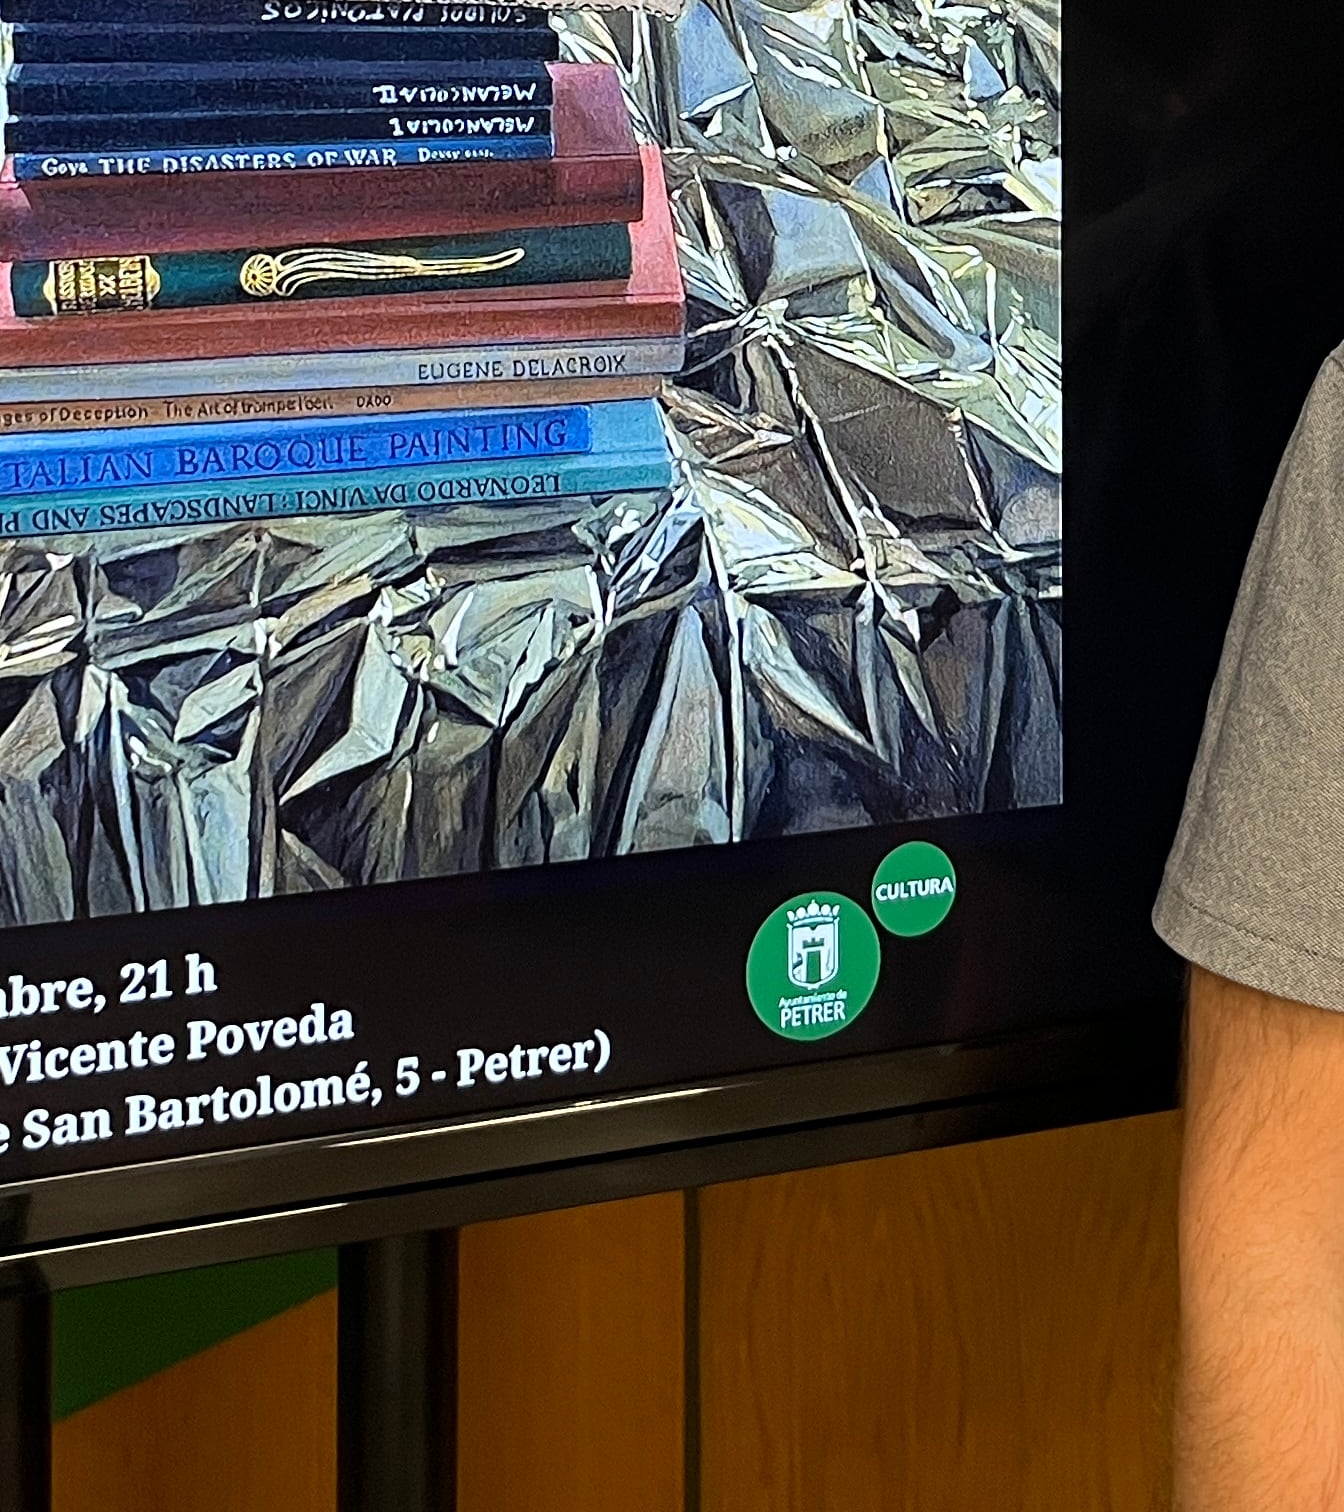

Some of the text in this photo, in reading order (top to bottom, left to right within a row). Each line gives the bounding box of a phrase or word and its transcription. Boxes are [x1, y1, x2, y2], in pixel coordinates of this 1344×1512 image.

[399, 82, 537, 103] MELANCOLIA
[406, 116, 535, 135] MELANCOLIA
[99, 156, 151, 175] THE
[162, 152, 297, 174] DISASTERS
[306, 151, 338, 167] OF
[344, 148, 397, 167] WAR
[418, 354, 627, 380] EUGENE DELACROIX
[40, 407, 57, 423] of
[59, 404, 149, 423] Deception
[163, 399, 194, 418] The
[197, 400, 221, 418] Art
[223, 398, 239, 417] of
[174, 435, 368, 476] BAROQUE
[389, 419, 567, 460] PAINTING
[376, 483, 406, 504] DA
[417, 474, 561, 501] LEONARDO
[32, 506, 91, 530] AND
[100, 493, 276, 526] LANDSCAPES
[875, 876, 955, 902] CULTURA
[119, 958, 173, 1003] 21
[184, 952, 218, 995] h
[780, 1000, 846, 1029] PETRER
[186, 1002, 355, 1061] Poveda
[22, 1102, 113, 1152] San
[124, 1060, 383, 1135] Bartolomé,
[395, 1056, 421, 1096] 5
[456, 1028, 611, 1087] Petrer)
